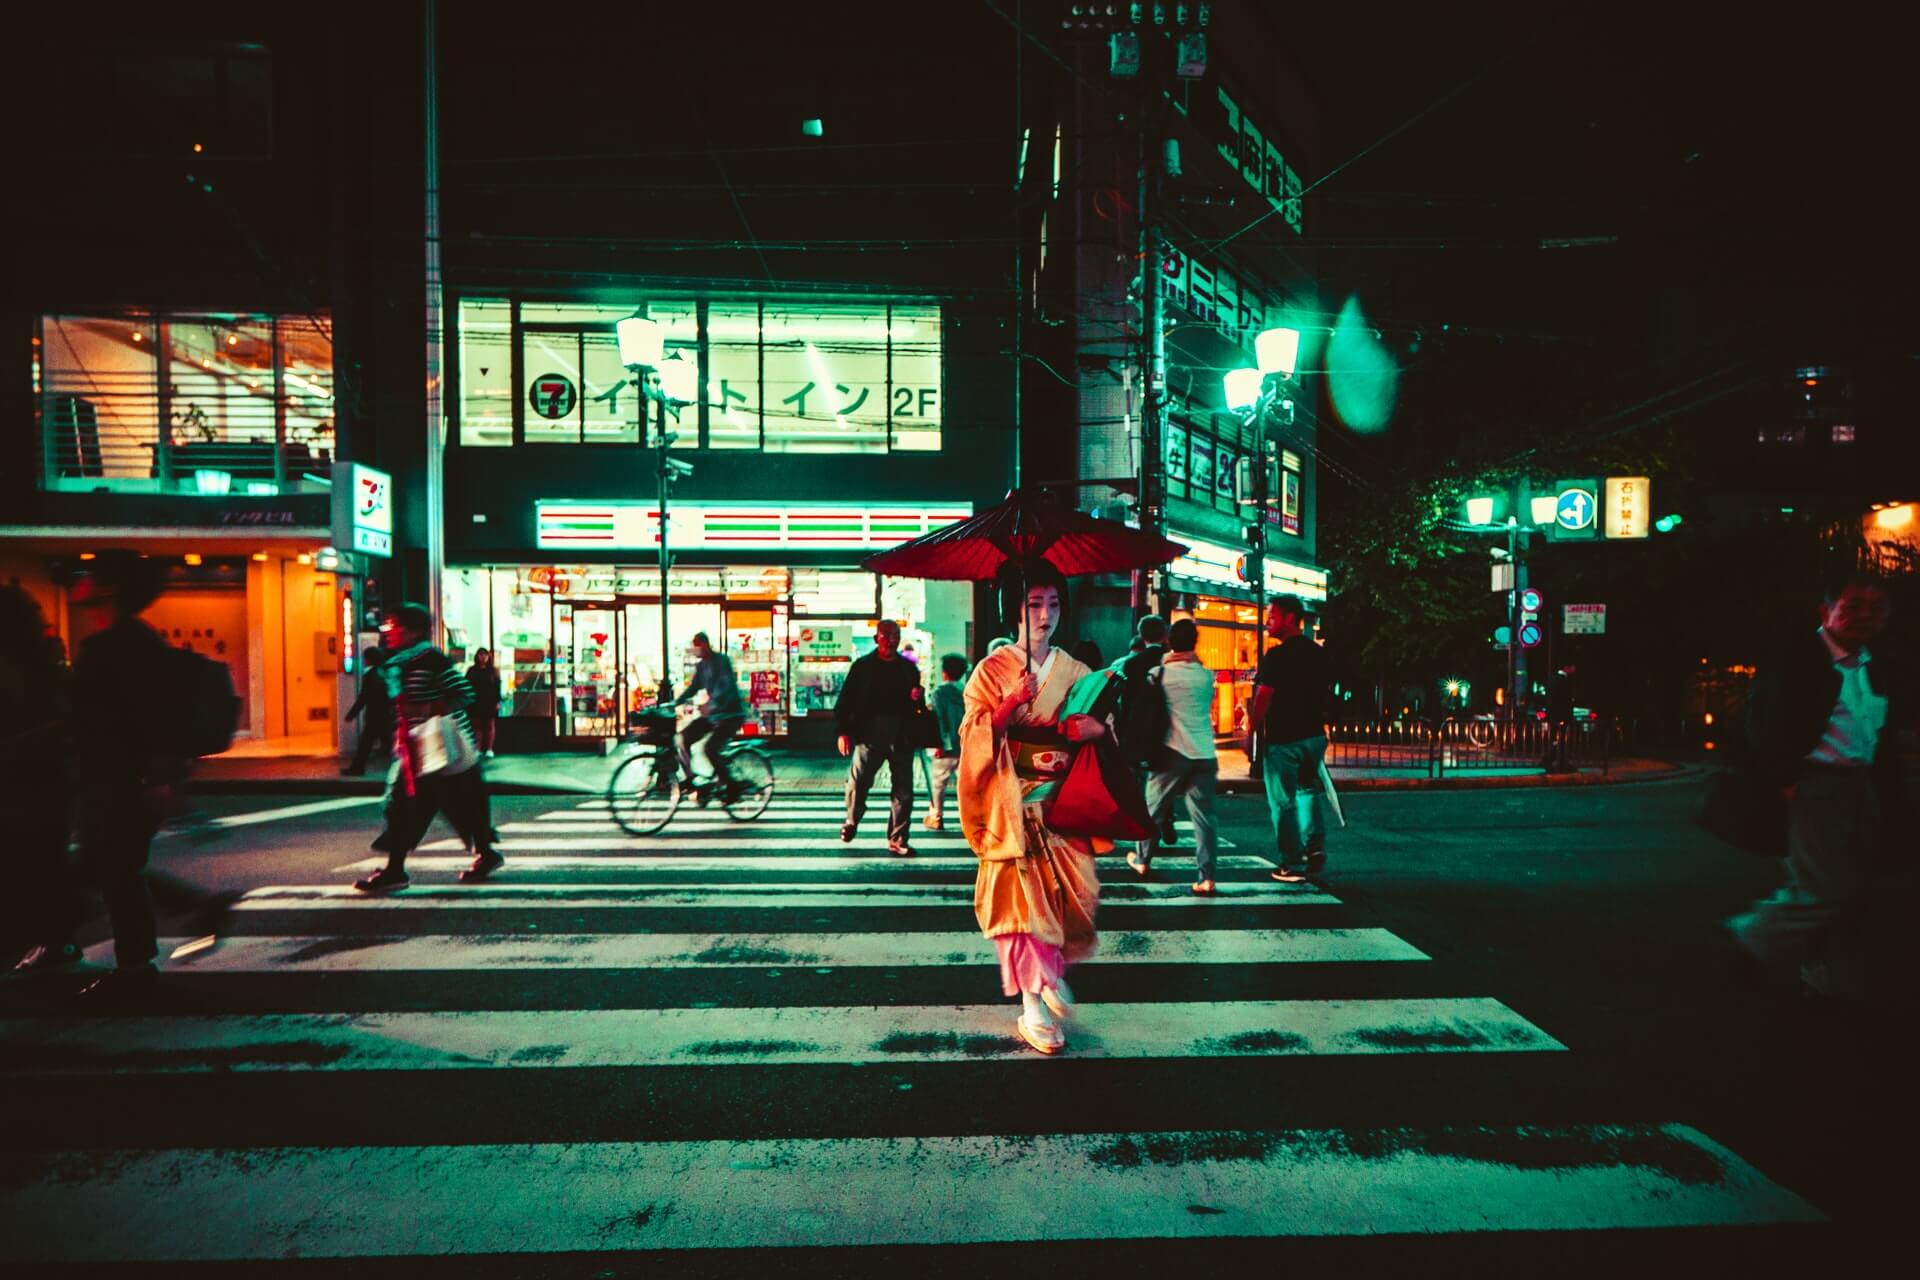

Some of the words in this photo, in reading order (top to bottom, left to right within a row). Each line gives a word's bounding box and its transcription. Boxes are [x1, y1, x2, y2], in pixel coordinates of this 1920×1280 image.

[594, 379, 870, 417] イトイン
[893, 388, 938, 416] 2F
